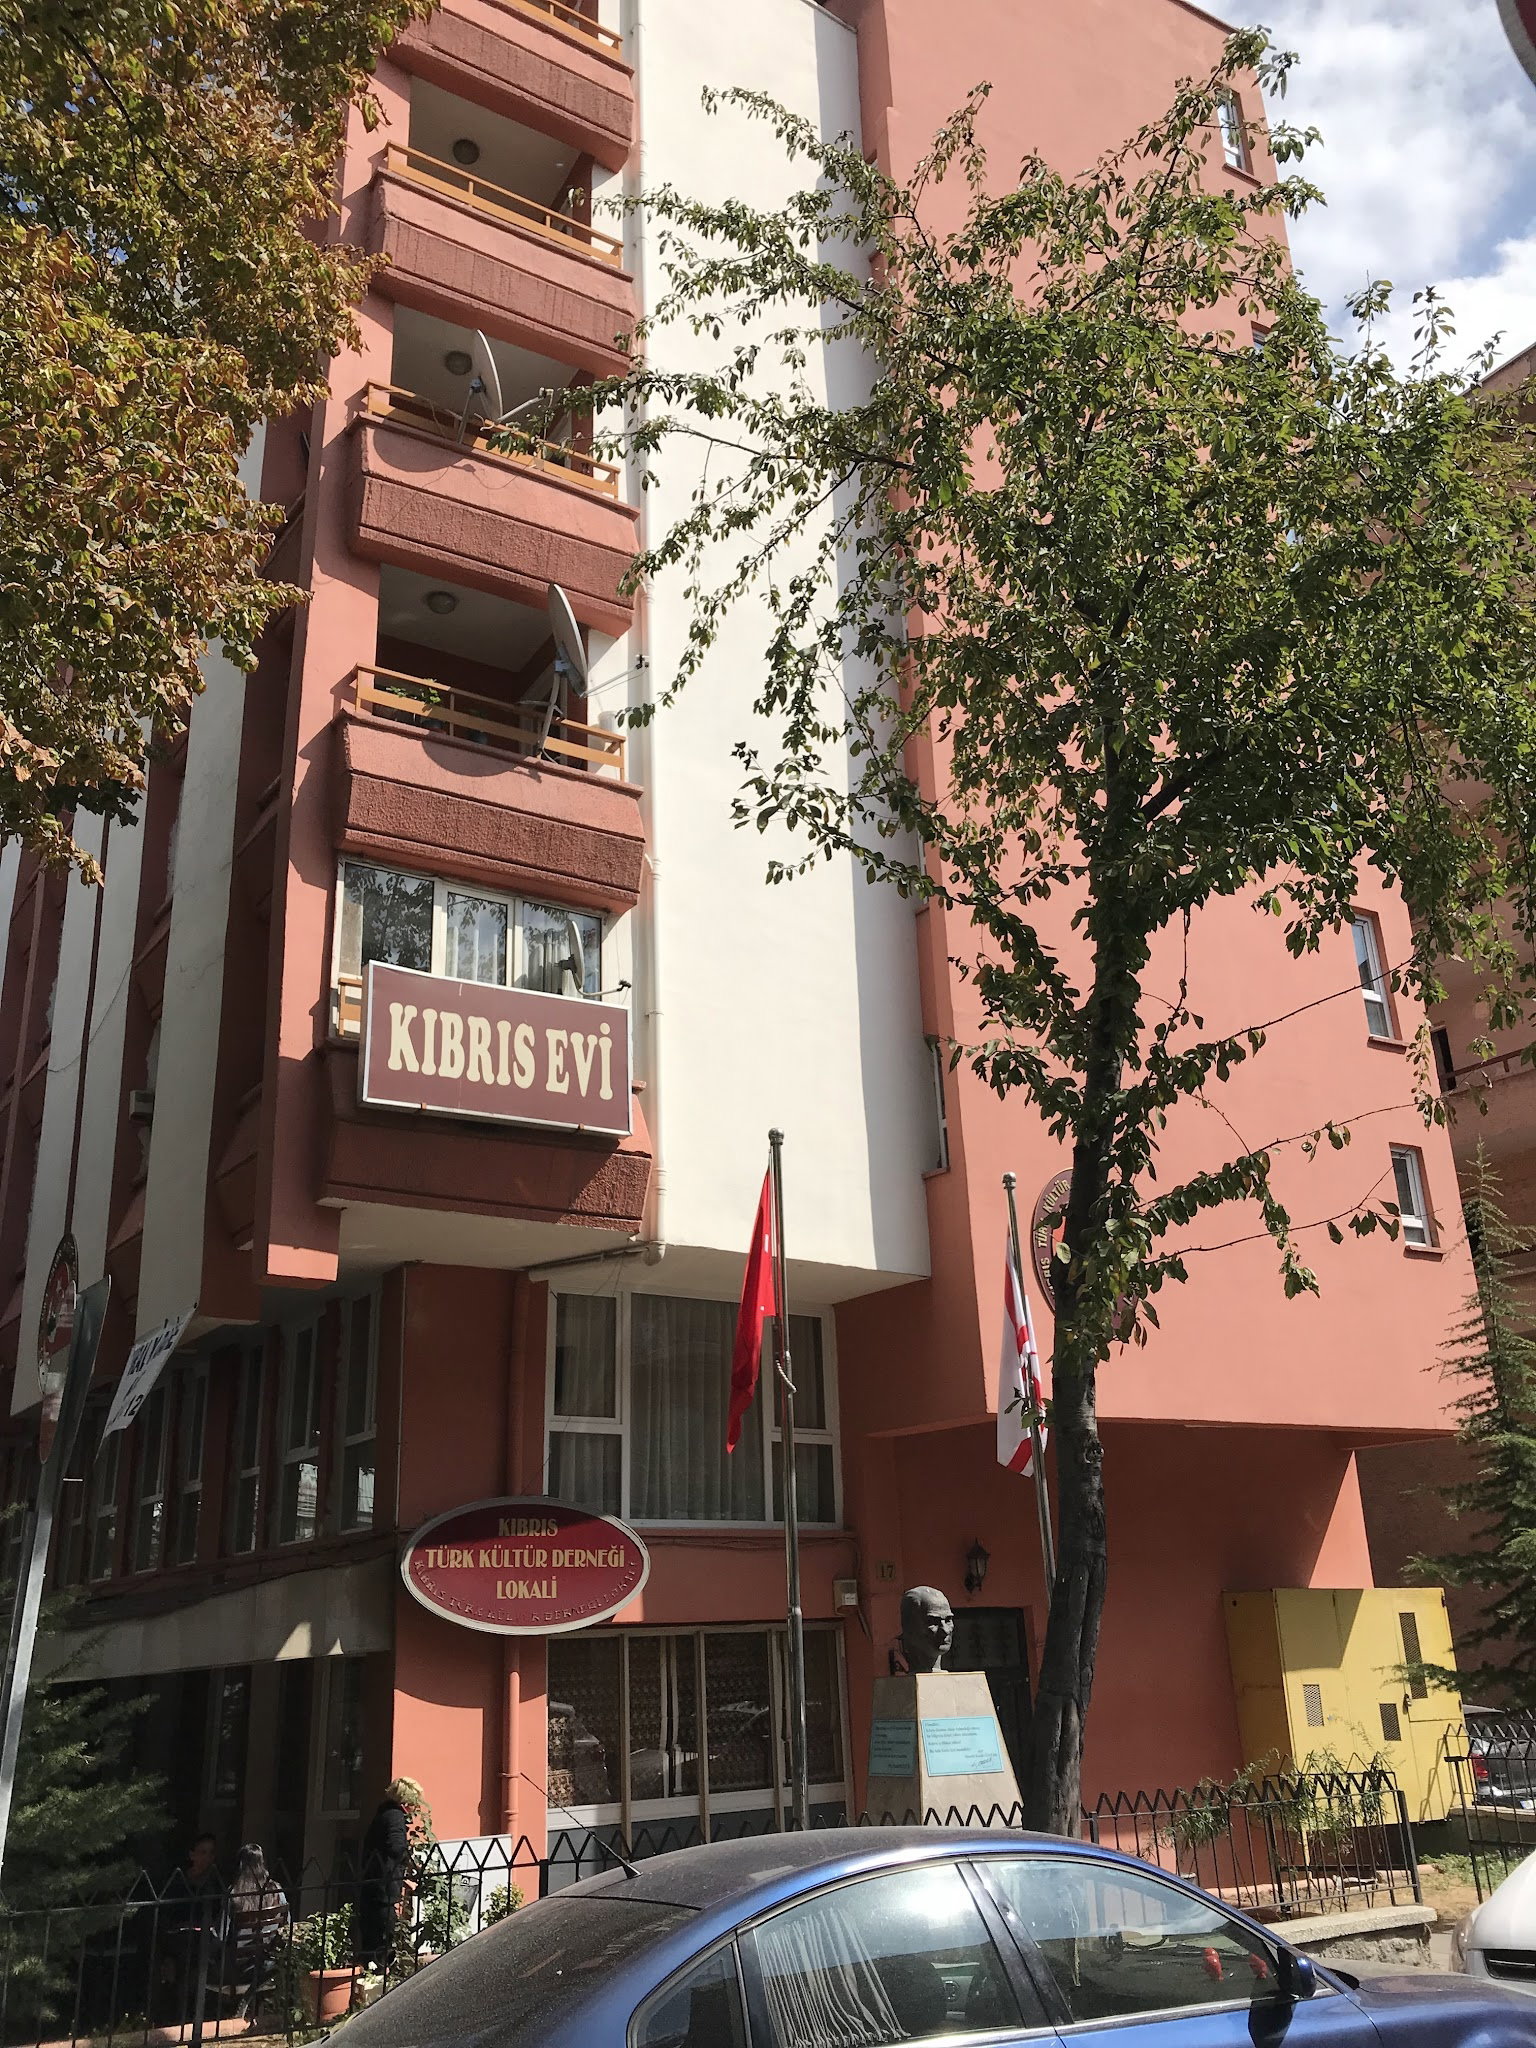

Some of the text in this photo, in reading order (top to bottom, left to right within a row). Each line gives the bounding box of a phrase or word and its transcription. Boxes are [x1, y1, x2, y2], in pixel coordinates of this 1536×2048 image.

[387, 1001, 613, 1101] KIBRIS EVİ
[499, 1518, 559, 1537] KIBRIS
[425, 1544, 625, 1568] TÜRK KÜLTÜR DERNEĞİ
[878, 1564, 894, 1579] 17
[496, 1575, 557, 1600] LOKALİ
